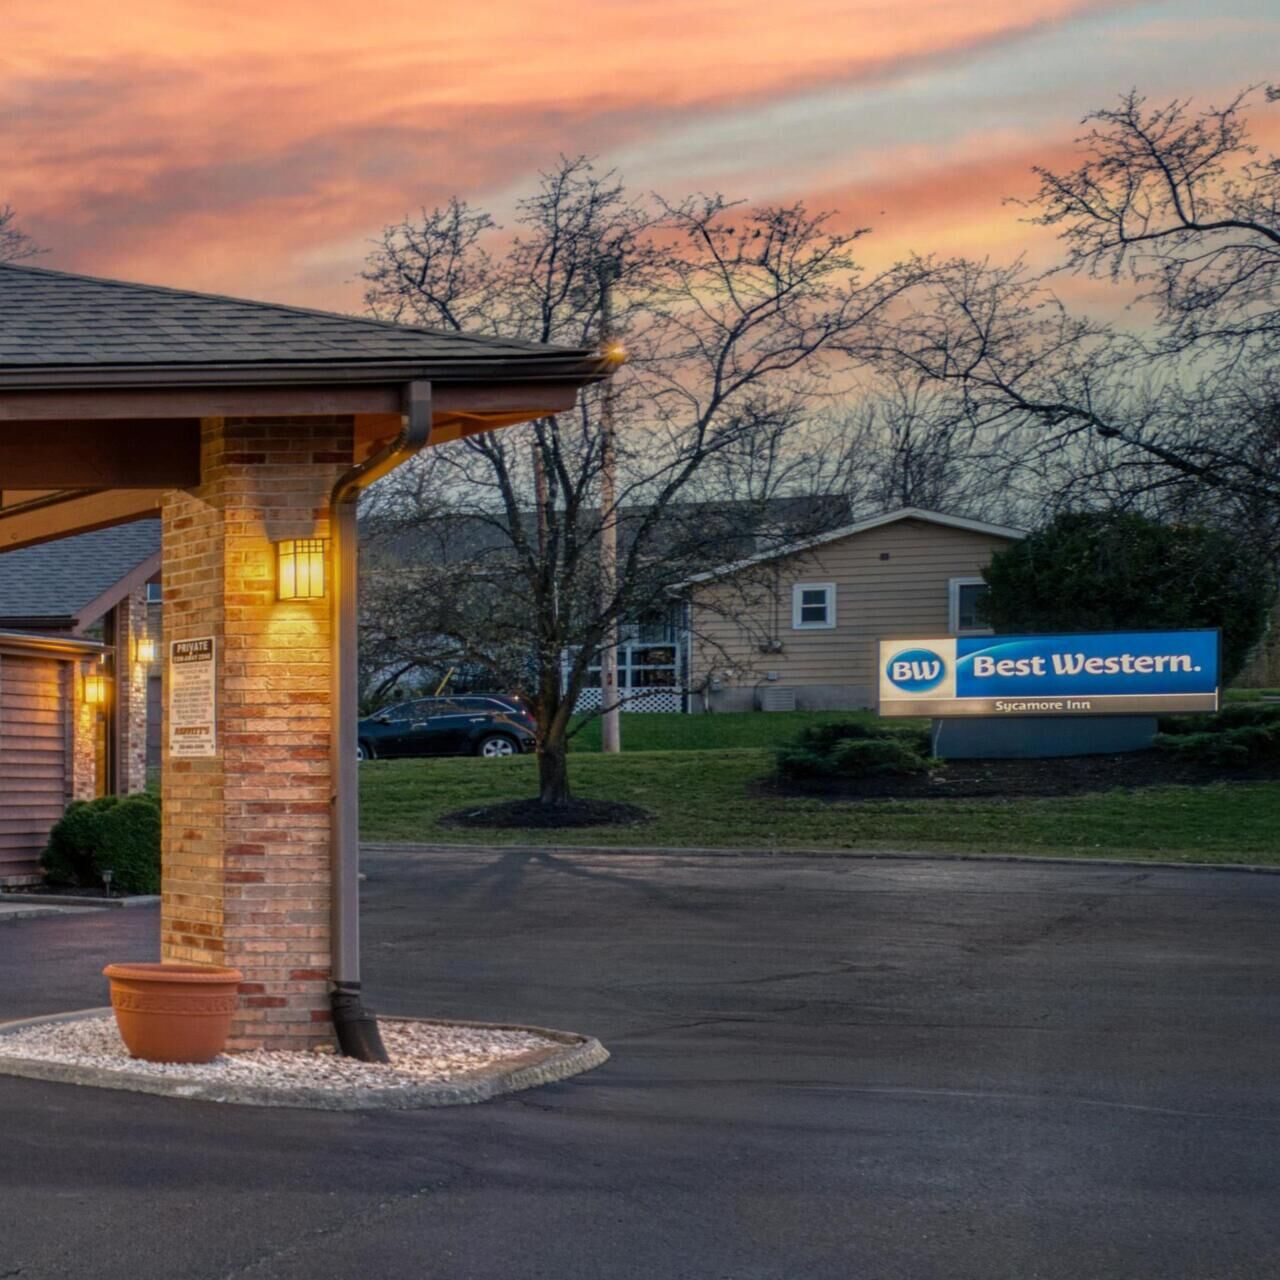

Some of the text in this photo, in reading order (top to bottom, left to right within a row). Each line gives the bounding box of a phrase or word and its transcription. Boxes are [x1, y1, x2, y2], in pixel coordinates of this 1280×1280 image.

[176, 640, 209, 653] PRIVATE
[892, 661, 940, 681] BW
[973, 655, 1046, 677] Best
[995, 699, 1091, 712] Sycamore Inn
